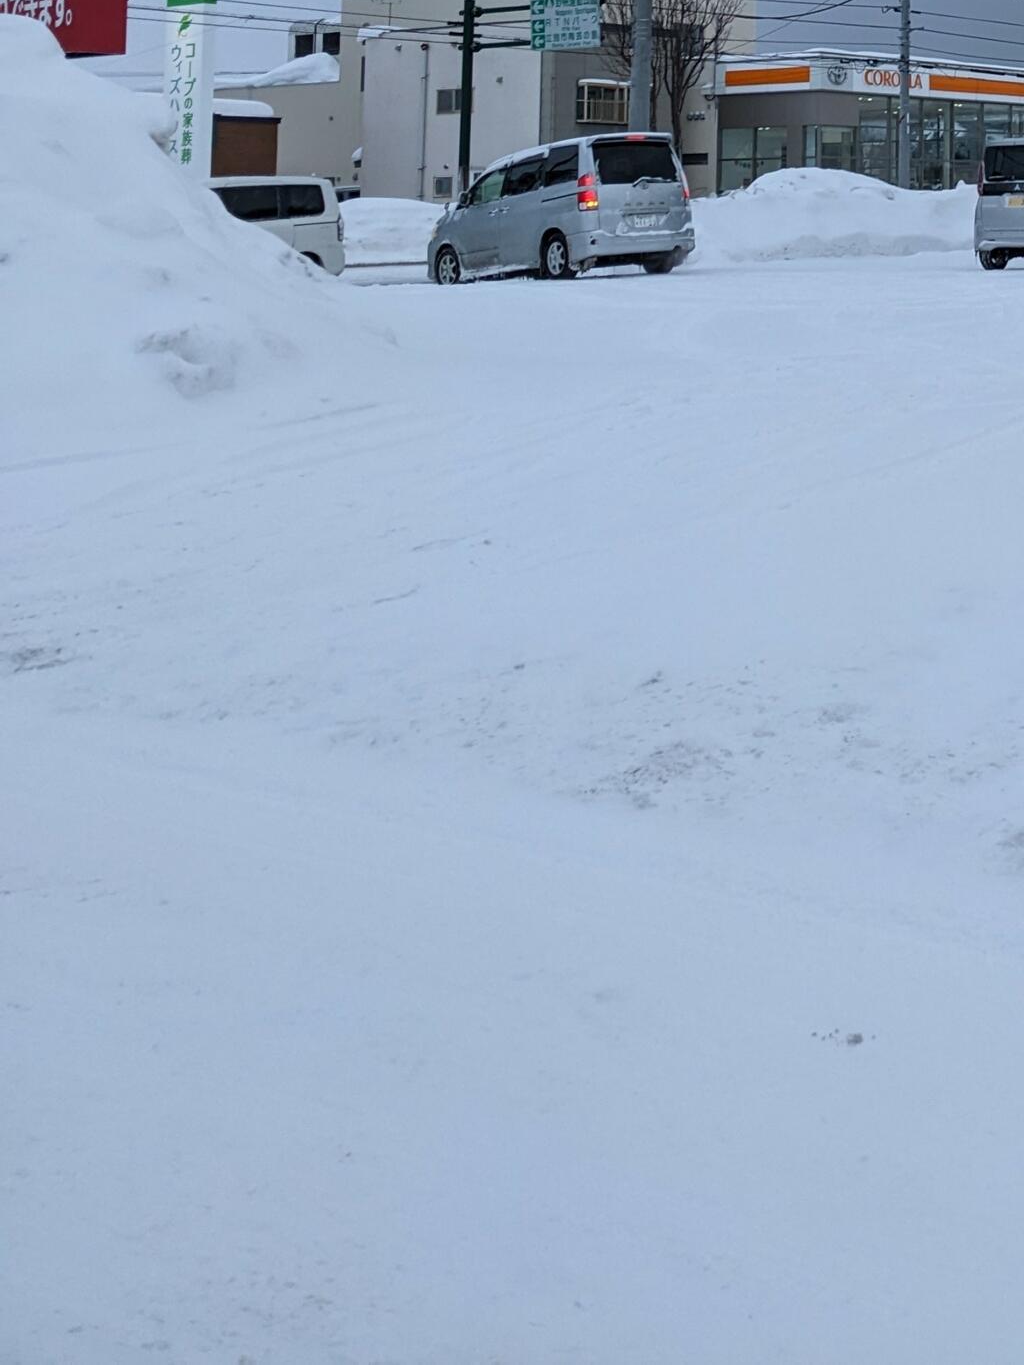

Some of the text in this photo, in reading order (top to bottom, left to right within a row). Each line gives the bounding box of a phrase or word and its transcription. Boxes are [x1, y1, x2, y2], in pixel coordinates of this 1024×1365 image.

[180, 43, 196, 165] コープの家族葬
